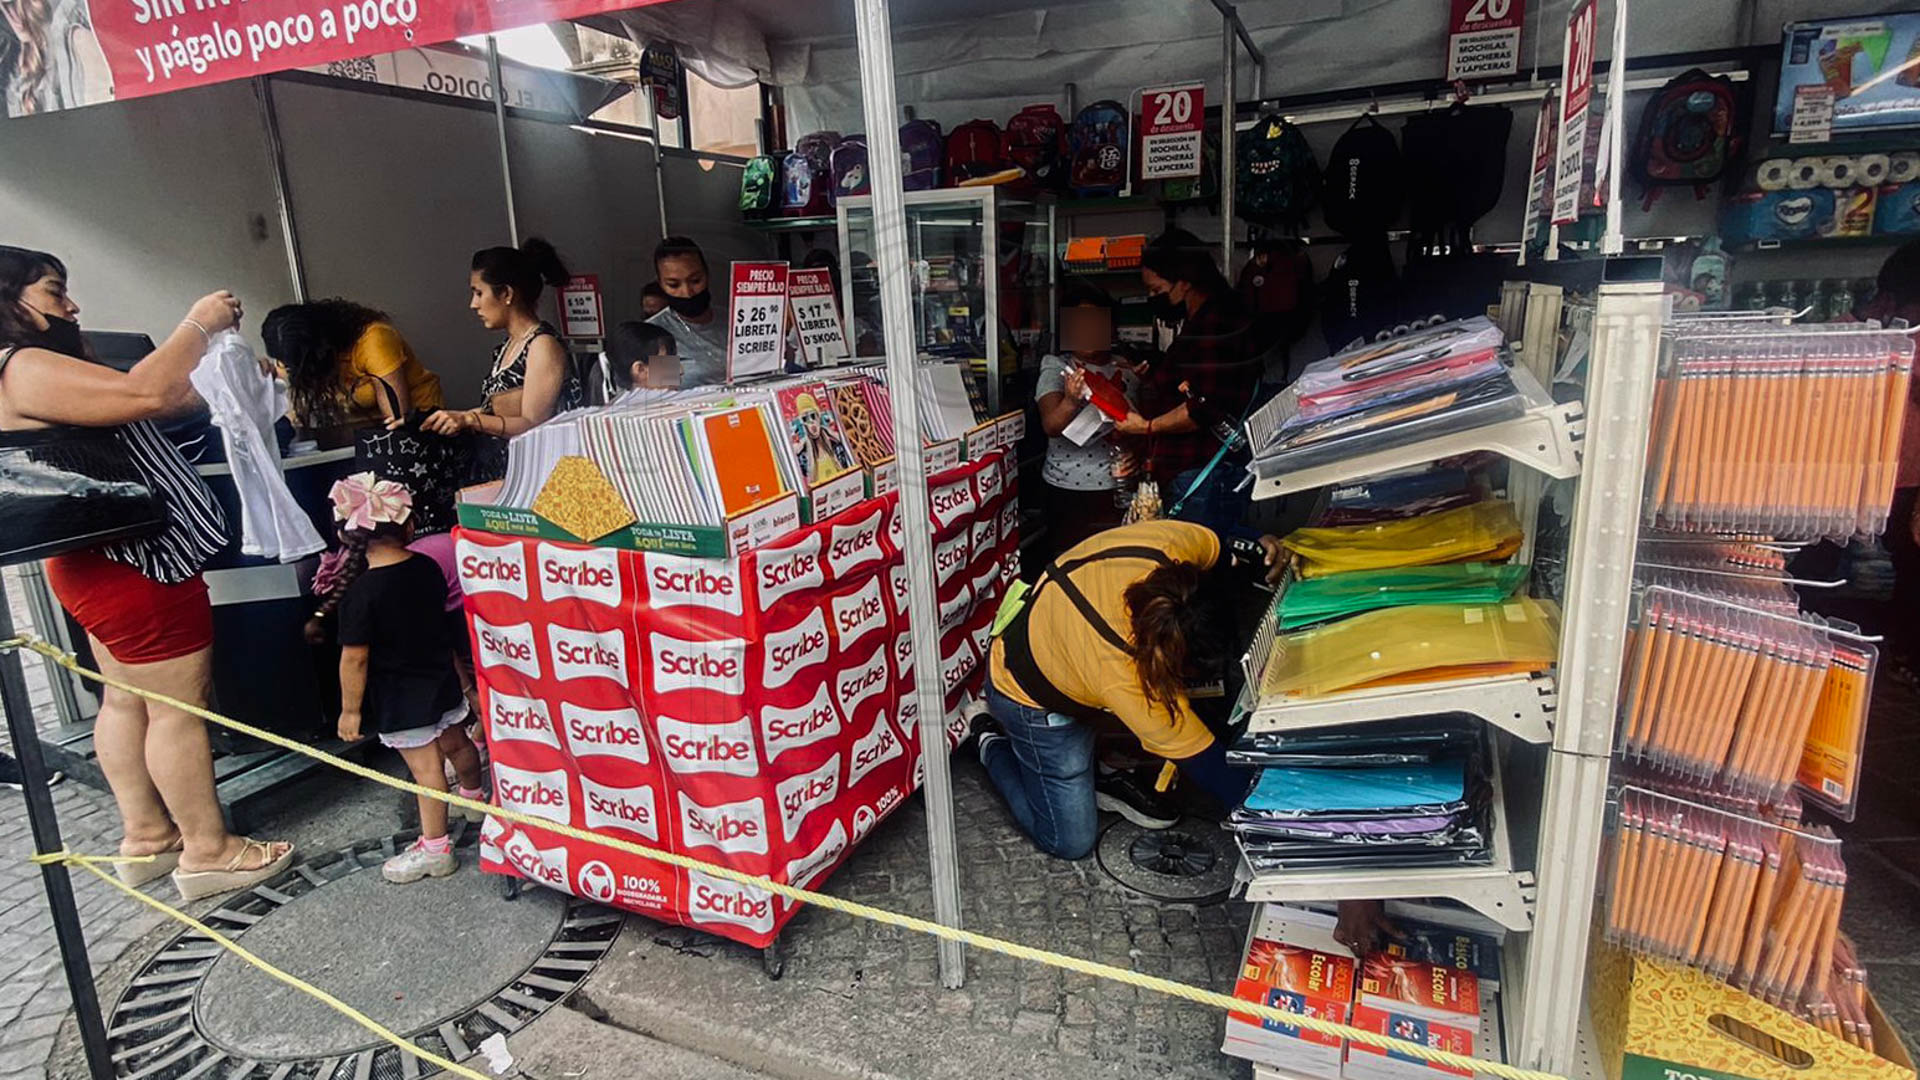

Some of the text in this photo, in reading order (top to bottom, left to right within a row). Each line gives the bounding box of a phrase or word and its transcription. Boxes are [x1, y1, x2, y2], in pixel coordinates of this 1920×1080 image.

[135, 0, 418, 83] y págalo poco a poco
[1571, 4, 1592, 93] 20
[1155, 91, 1192, 125] 20
[1148, 152, 1194, 164] LONCHERAS
[736, 280, 785, 294] SIEMPRE BAJO
[749, 269, 775, 281] PRECIO
[737, 308, 745, 323] $
[750, 306, 766, 322] 26
[798, 307, 806, 320] $
[808, 305, 821, 318] 17
[798, 318, 837, 332] LIBRETA
[735, 323, 778, 338] LIBRETA
[738, 340, 776, 355] SCRIBE
[935, 487, 969, 513] Scribe
[509, 511, 540, 526] LISTA
[662, 528, 697, 543] LISTA
[832, 529, 873, 560] Scribe
[462, 556, 521, 582] Scribe
[544, 560, 614, 587] Scribe
[653, 567, 734, 595] Scribe
[763, 553, 814, 589] Scribe
[840, 596, 880, 633] Scribe
[557, 641, 620, 669] Scribe
[660, 650, 737, 678] Scribe
[772, 630, 824, 671] Scribe
[841, 665, 885, 704] Scribe
[571, 719, 640, 746] Scribe
[768, 704, 834, 742] Scribe
[666, 735, 750, 761] Scribe
[855, 730, 895, 771] Scribe
[500, 778, 564, 806] Scribe
[784, 774, 834, 820] Scribe
[588, 791, 650, 824] Scribe
[622, 875, 660, 892] 100%
[696, 884, 767, 919] Scribe
[1308, 953, 1327, 992] Escolar
[1431, 966, 1447, 1006] Escolar
